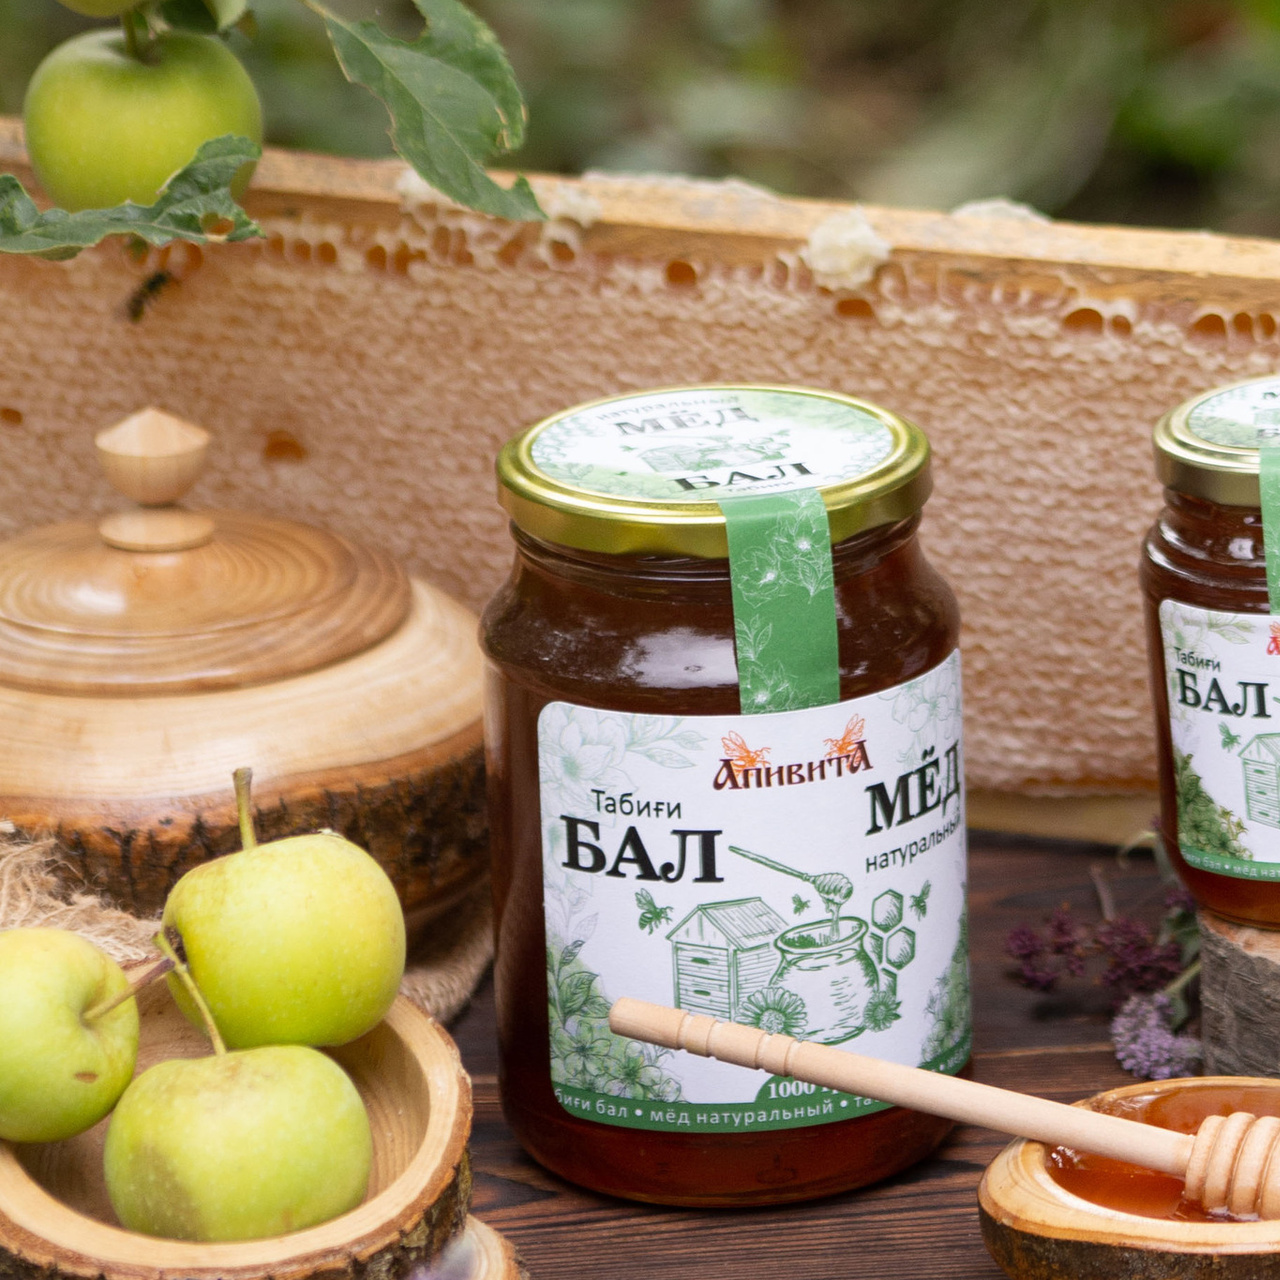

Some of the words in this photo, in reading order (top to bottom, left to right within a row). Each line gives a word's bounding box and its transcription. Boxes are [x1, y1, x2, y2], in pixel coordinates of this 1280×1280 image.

[614, 406, 760, 436] МЁД
[672, 462, 818, 492] БАЛ
[1173, 646, 1221, 672] Табиғи
[1176, 668, 1272, 718] БАЛ
[864, 738, 961, 837] МЁД
[590, 789, 682, 819] Табиғи
[559, 814, 725, 883] БАЛ
[1233, 865, 1258, 877] мёд
[767, 1081, 816, 1099] 1000
[595, 1099, 628, 1118] бал
[650, 1109, 690, 1126] мёд
[696, 1100, 834, 1127] натуральный
